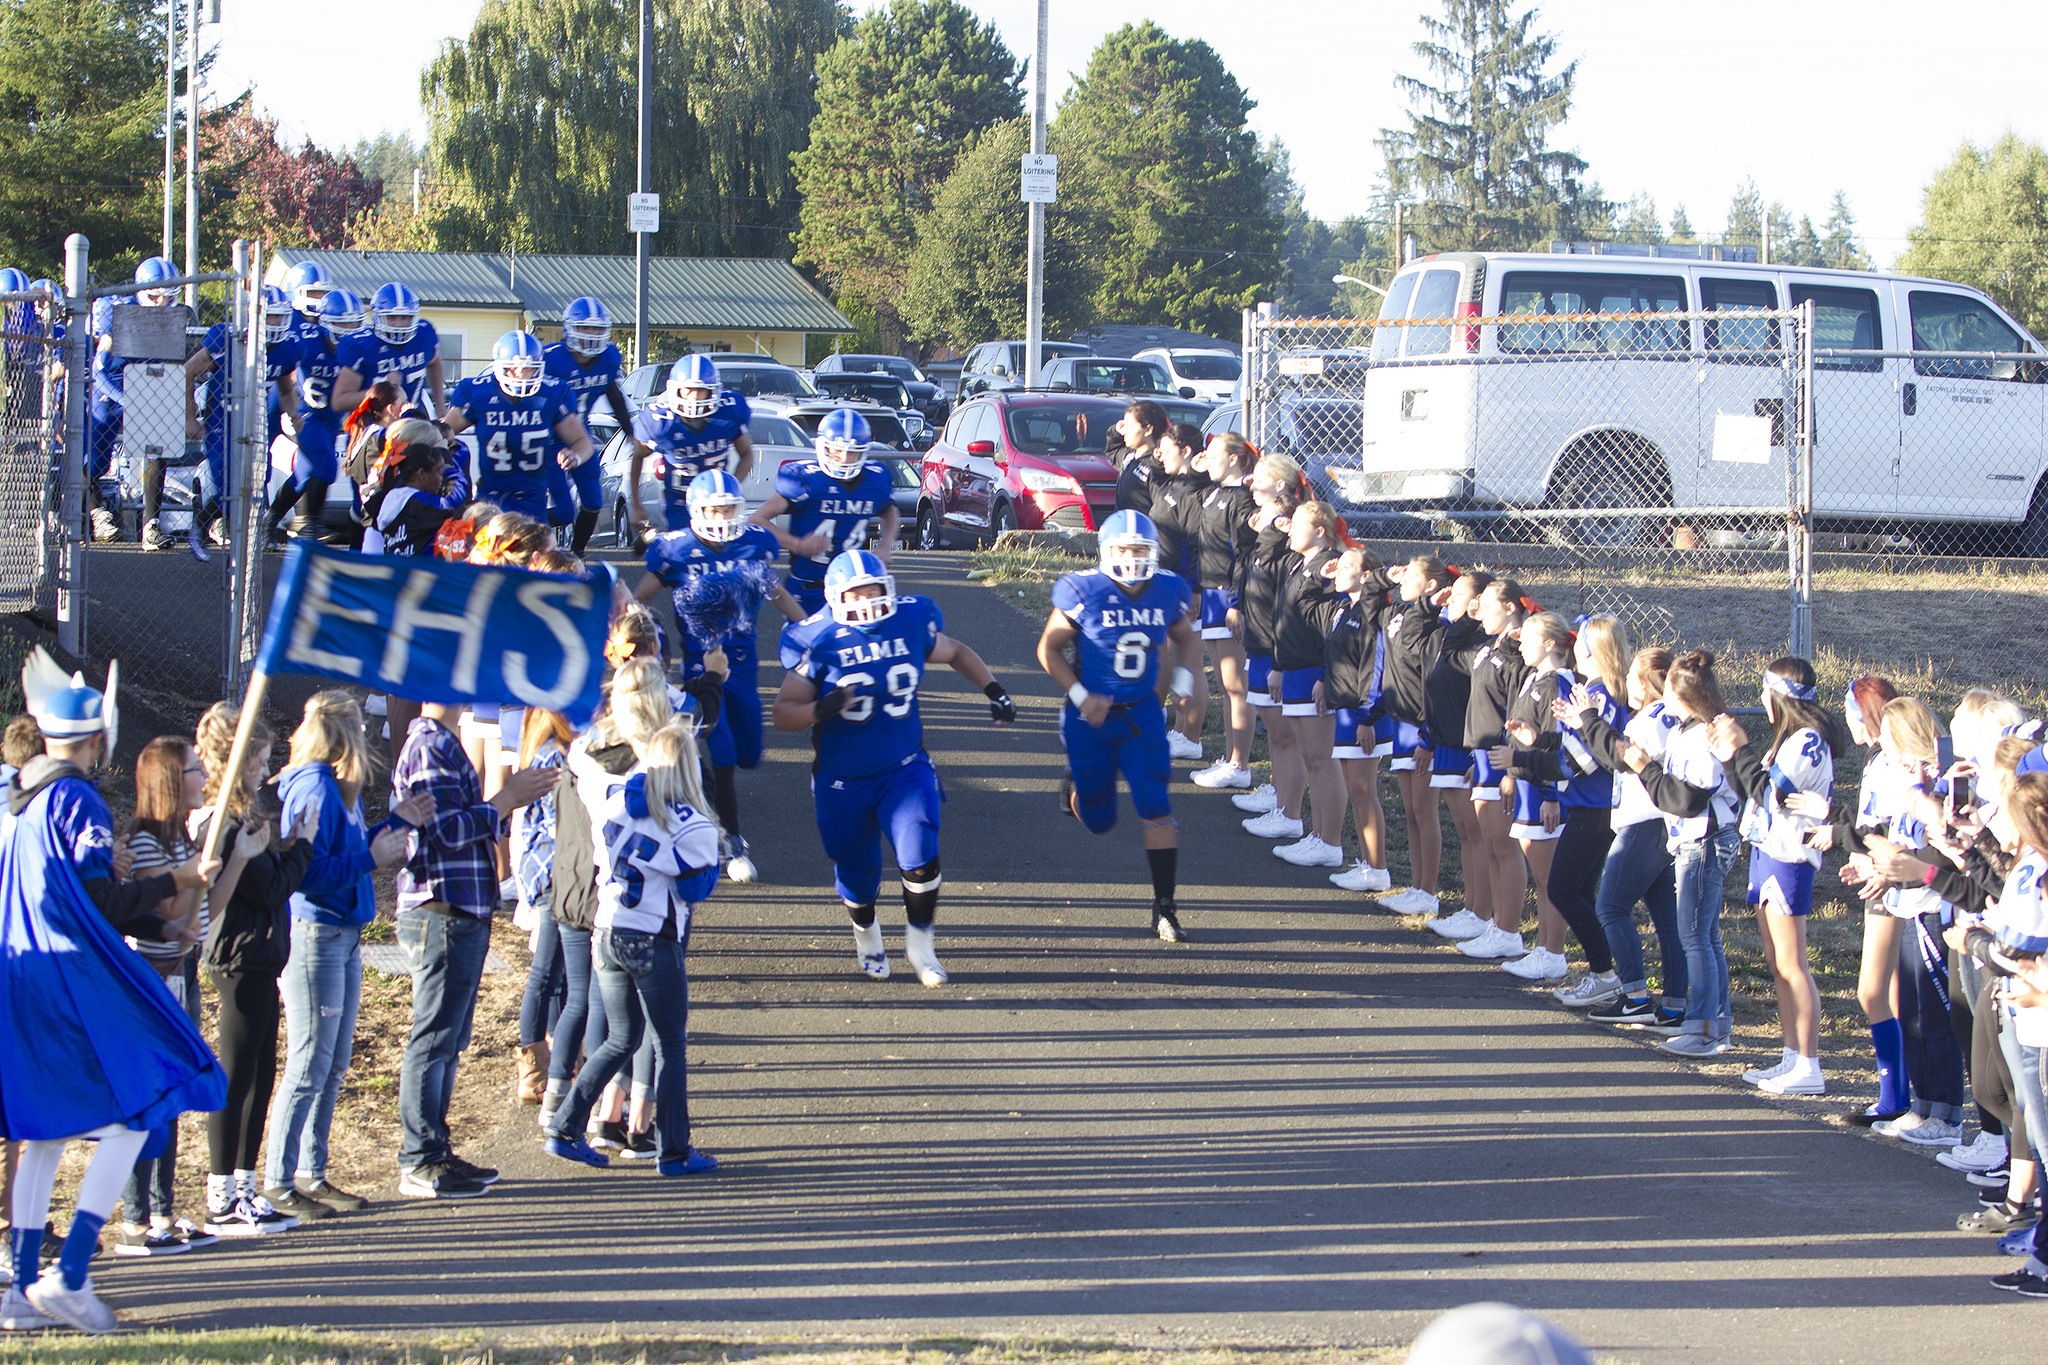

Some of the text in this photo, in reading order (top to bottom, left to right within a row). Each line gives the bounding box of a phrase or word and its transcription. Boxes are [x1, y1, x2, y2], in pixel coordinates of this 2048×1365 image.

[377, 352, 426, 374] ELMA
[485, 410, 544, 427] ELMA
[485, 428, 550, 472] 45
[673, 438, 728, 460] ELMA
[819, 499, 875, 515] ELMA
[810, 518, 871, 566] 44
[285, 553, 594, 712] EHS
[1101, 607, 1167, 628] ELMA
[836, 637, 911, 668] ELMA
[1112, 630, 1152, 680] 6
[835, 662, 920, 723] 69
